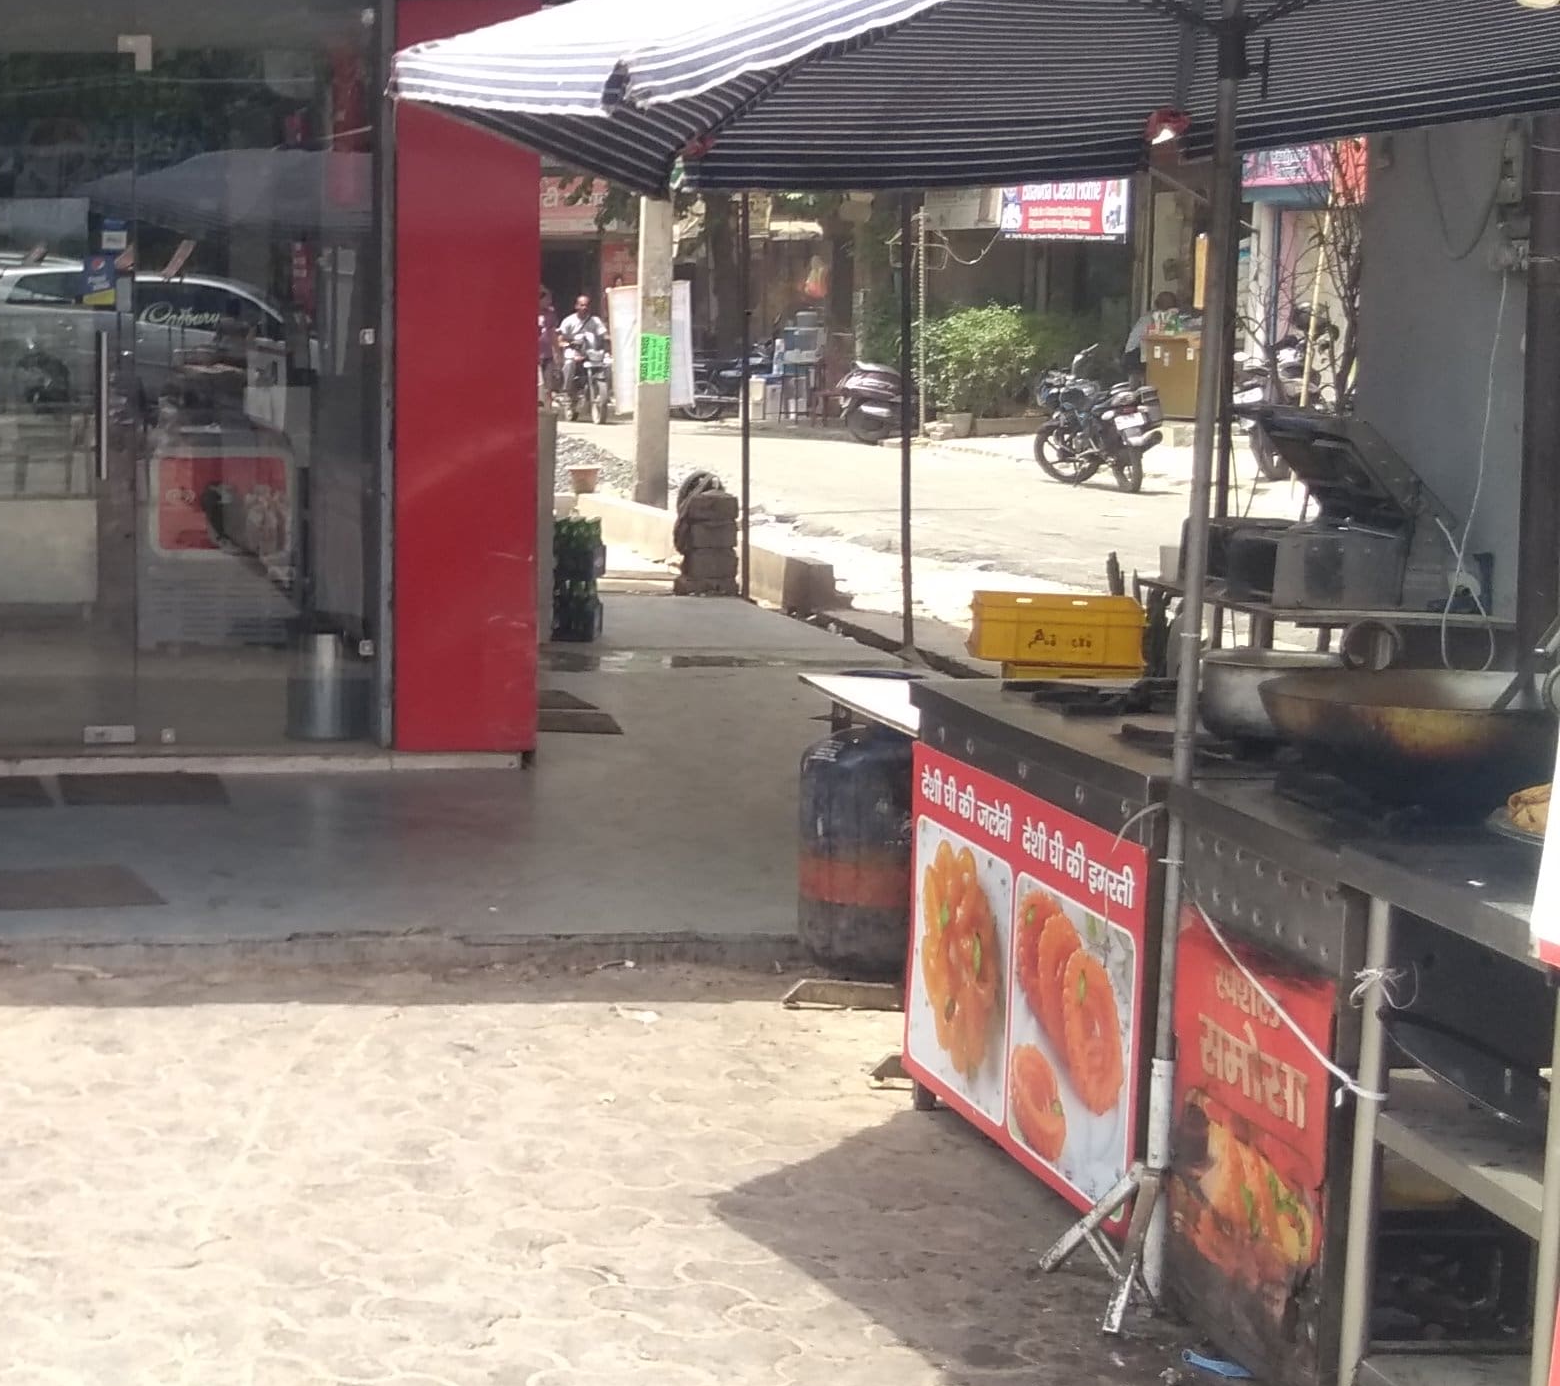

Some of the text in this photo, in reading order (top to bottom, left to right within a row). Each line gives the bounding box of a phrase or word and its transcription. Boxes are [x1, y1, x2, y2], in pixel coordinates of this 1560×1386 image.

[921, 764, 1012, 842] देशी घी की जलेबी
[1022, 816, 1135, 909] देशी घी की इमरती
[1199, 1012, 1308, 1130] समोसा
